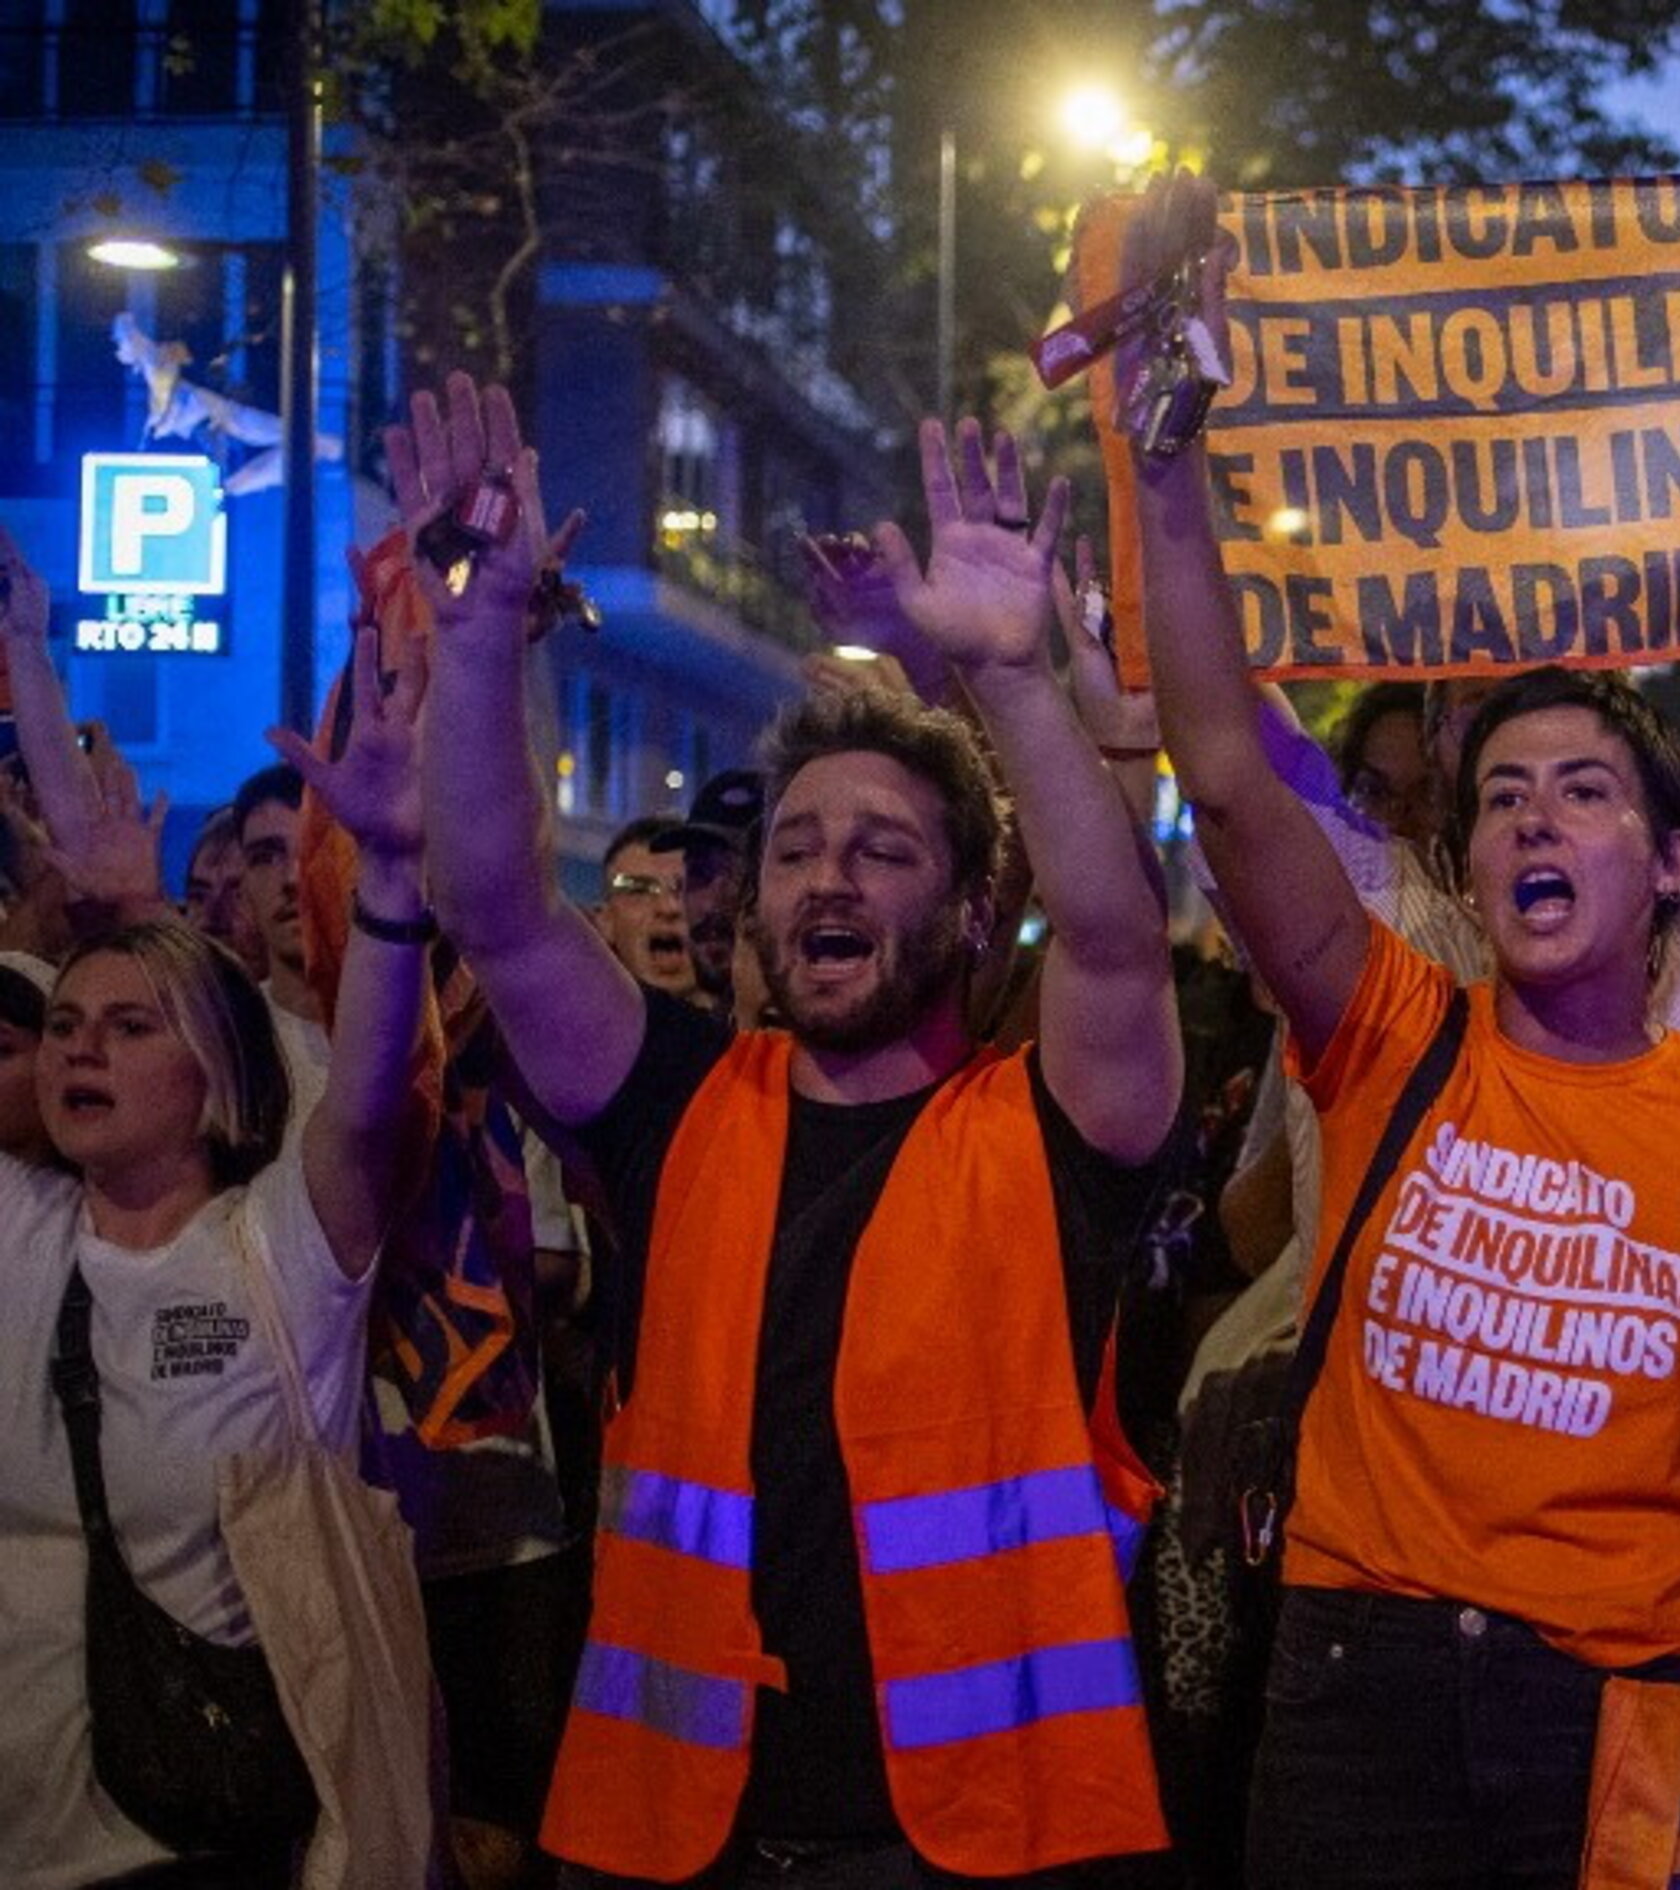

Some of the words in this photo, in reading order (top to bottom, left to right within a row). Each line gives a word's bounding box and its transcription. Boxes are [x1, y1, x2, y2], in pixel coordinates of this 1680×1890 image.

[111, 474, 195, 576] P
[1207, 452, 1263, 541] E
[1392, 1177, 1454, 1251] DE
[1426, 1121, 1636, 1229] SINDICATO
[1367, 1253, 1399, 1314] E
[1397, 1262, 1678, 1379] INQUILINOS
[1363, 1318, 1413, 1392] DE
[1412, 1340, 1613, 1438] MADRID
